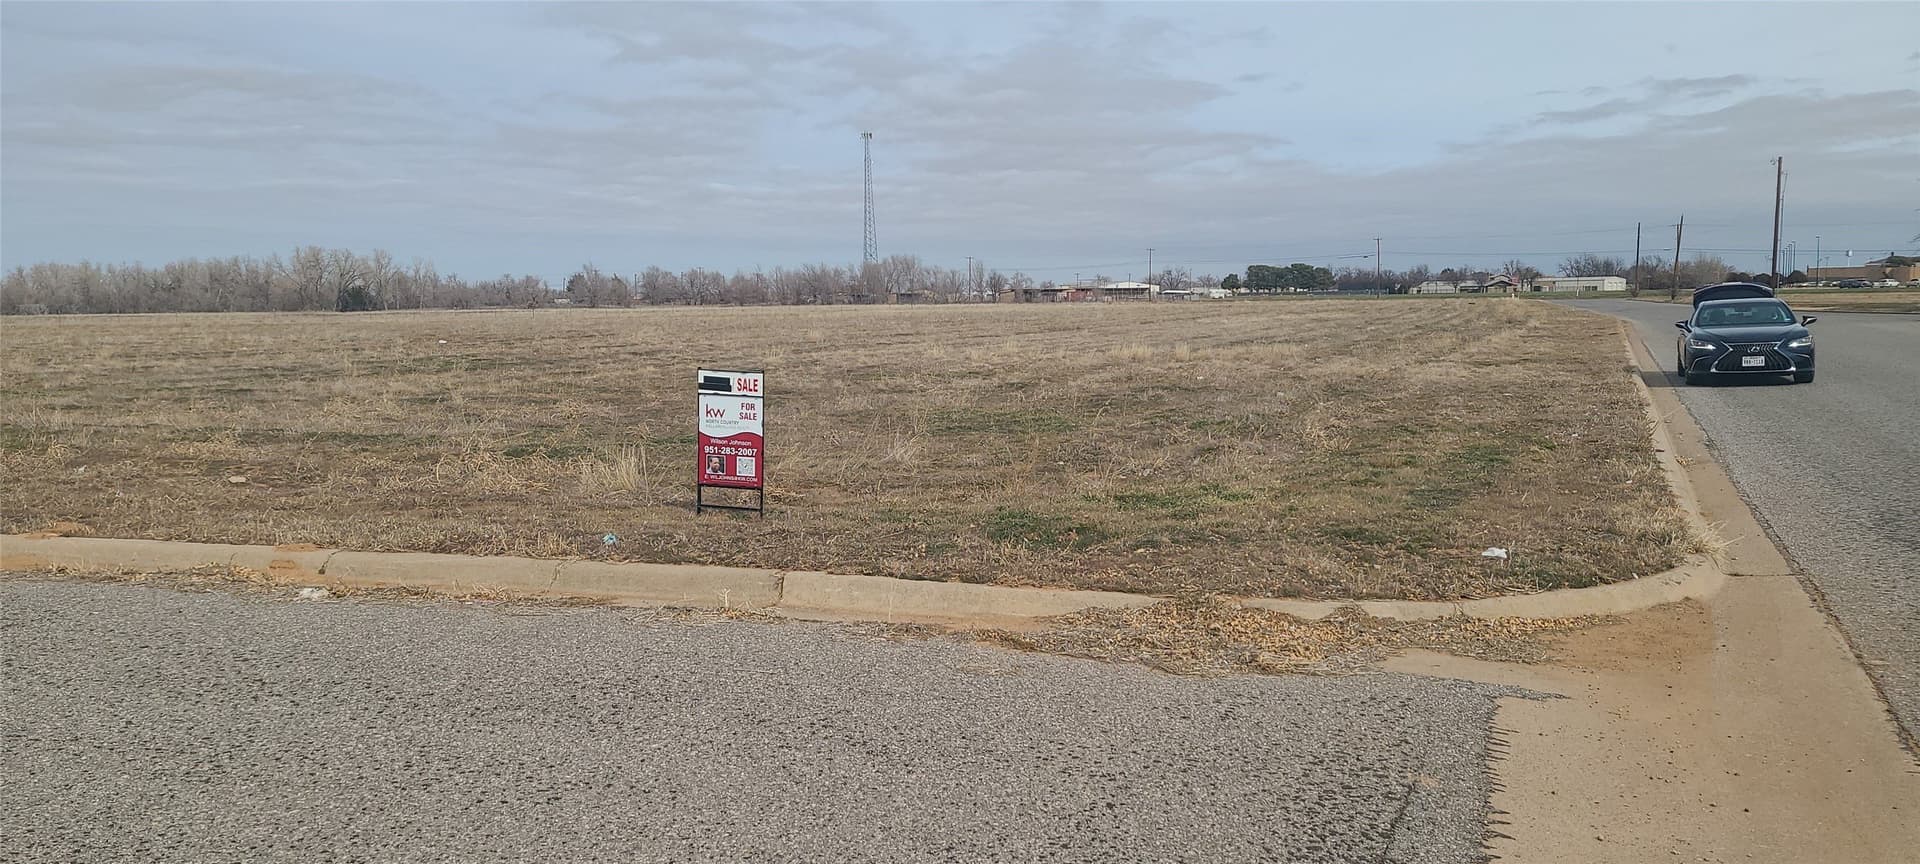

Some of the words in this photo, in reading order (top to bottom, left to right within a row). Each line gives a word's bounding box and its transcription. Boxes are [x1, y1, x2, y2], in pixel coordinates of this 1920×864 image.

[737, 378, 758, 392] SALE
[706, 403, 726, 418] kw
[741, 402, 756, 410] FOR
[739, 412, 757, 420] SALE
[704, 446, 758, 456] 951-283-2007
